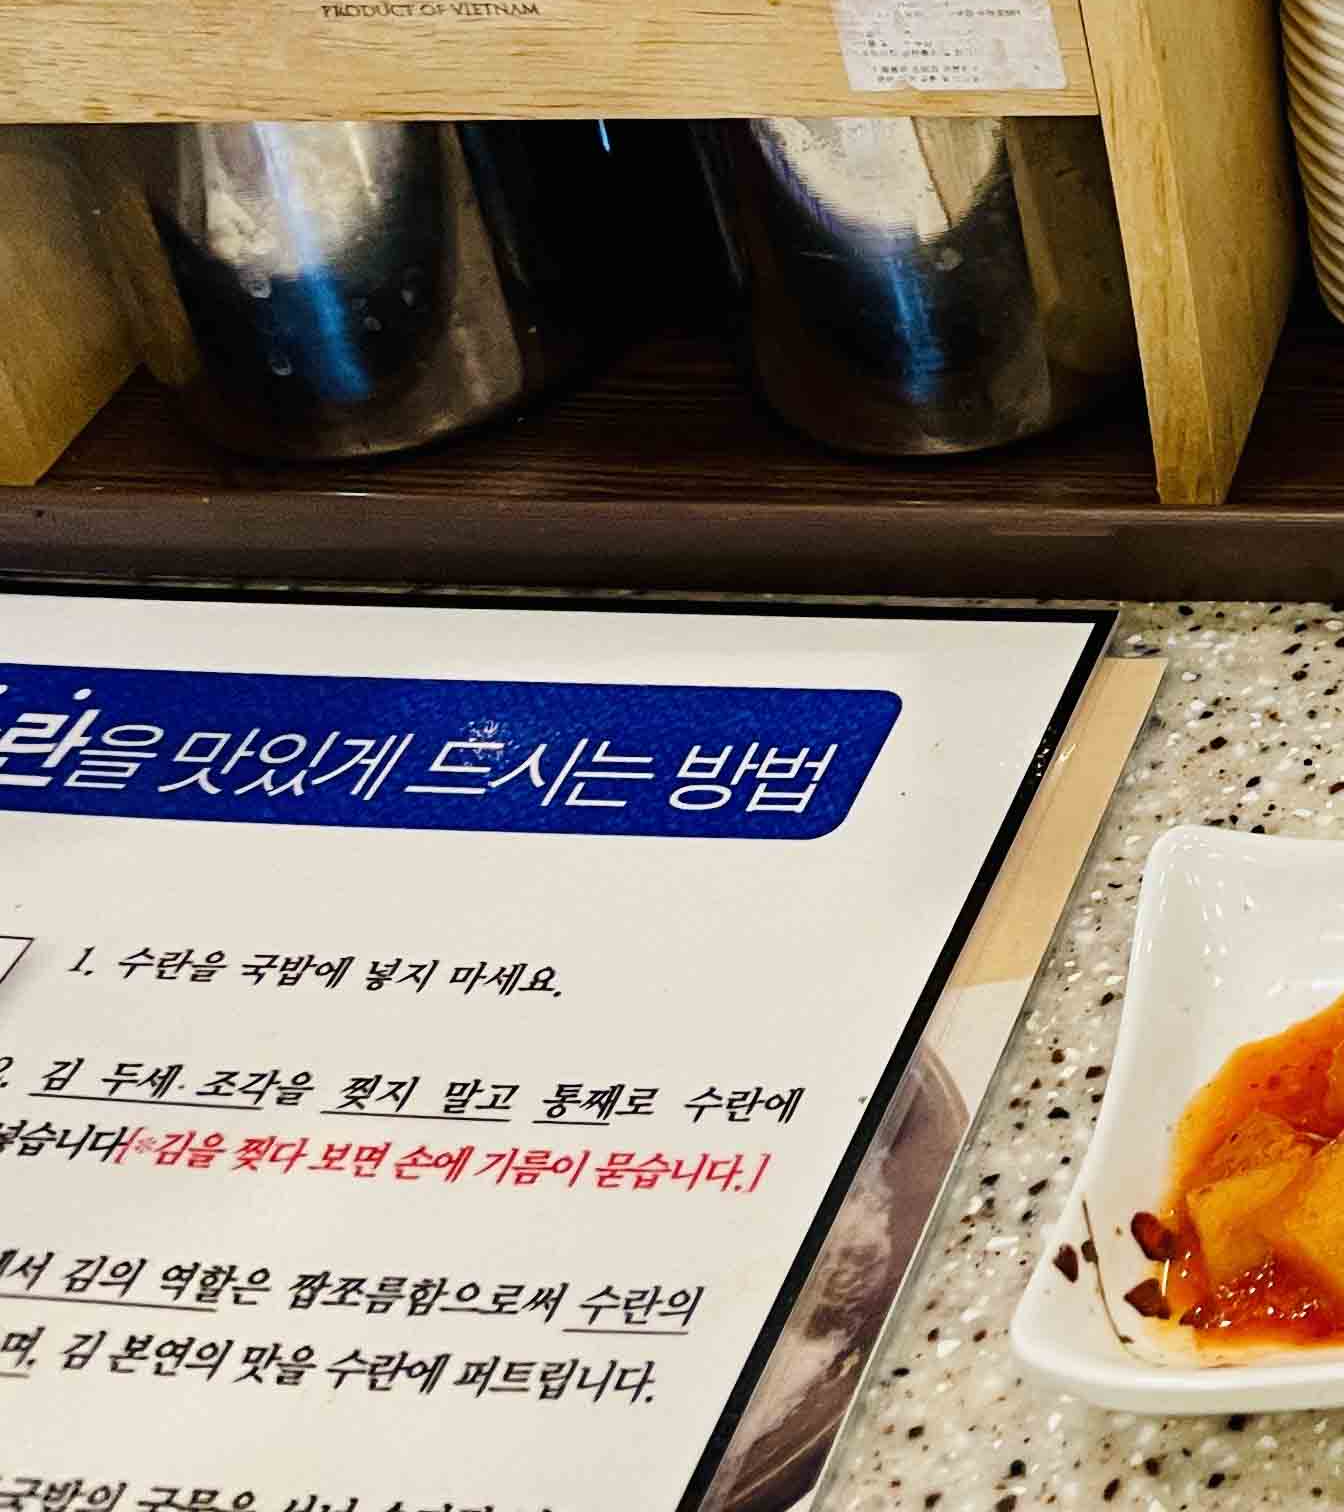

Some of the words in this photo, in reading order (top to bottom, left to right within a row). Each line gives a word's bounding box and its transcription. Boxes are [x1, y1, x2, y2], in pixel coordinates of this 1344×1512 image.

[320, 4, 416, 18] PRODUCT
[419, 3, 449, 17] OF
[451, 2, 541, 17] VIETNAM
[157, 727, 416, 801] 맛있게
[403, 737, 656, 808] 드시는
[668, 741, 839, 814] 방법
[67, 945, 97, 977] 1.
[117, 947, 228, 983] 수란을
[240, 952, 357, 989] 국밥에
[365, 957, 440, 994] 넣지
[448, 960, 563, 998] 마세요.
[42, 1057, 86, 1092] 김
[195, 1069, 316, 1106] 조각을
[336, 1074, 421, 1112] 찢지
[442, 1078, 520, 1115] 말고
[542, 1082, 661, 1121] 통째로
[684, 1086, 807, 1124] 수란에
[231, 1135, 312, 1174] 찢다
[307, 1142, 393, 1179] 보면
[393, 1144, 476, 1184] 손에
[474, 1147, 592, 1188] 기름이
[63, 1255, 148, 1298] 김의
[159, 1261, 273, 1306] 역할은
[578, 1284, 706, 1327] 수란의
[60, 1330, 107, 1371] 김
[108, 1334, 235, 1382] 본연의
[232, 1342, 318, 1387] 맛을
[325, 1349, 454, 1395] 수란에
[453, 1355, 657, 1405] 퍼트립니다.
